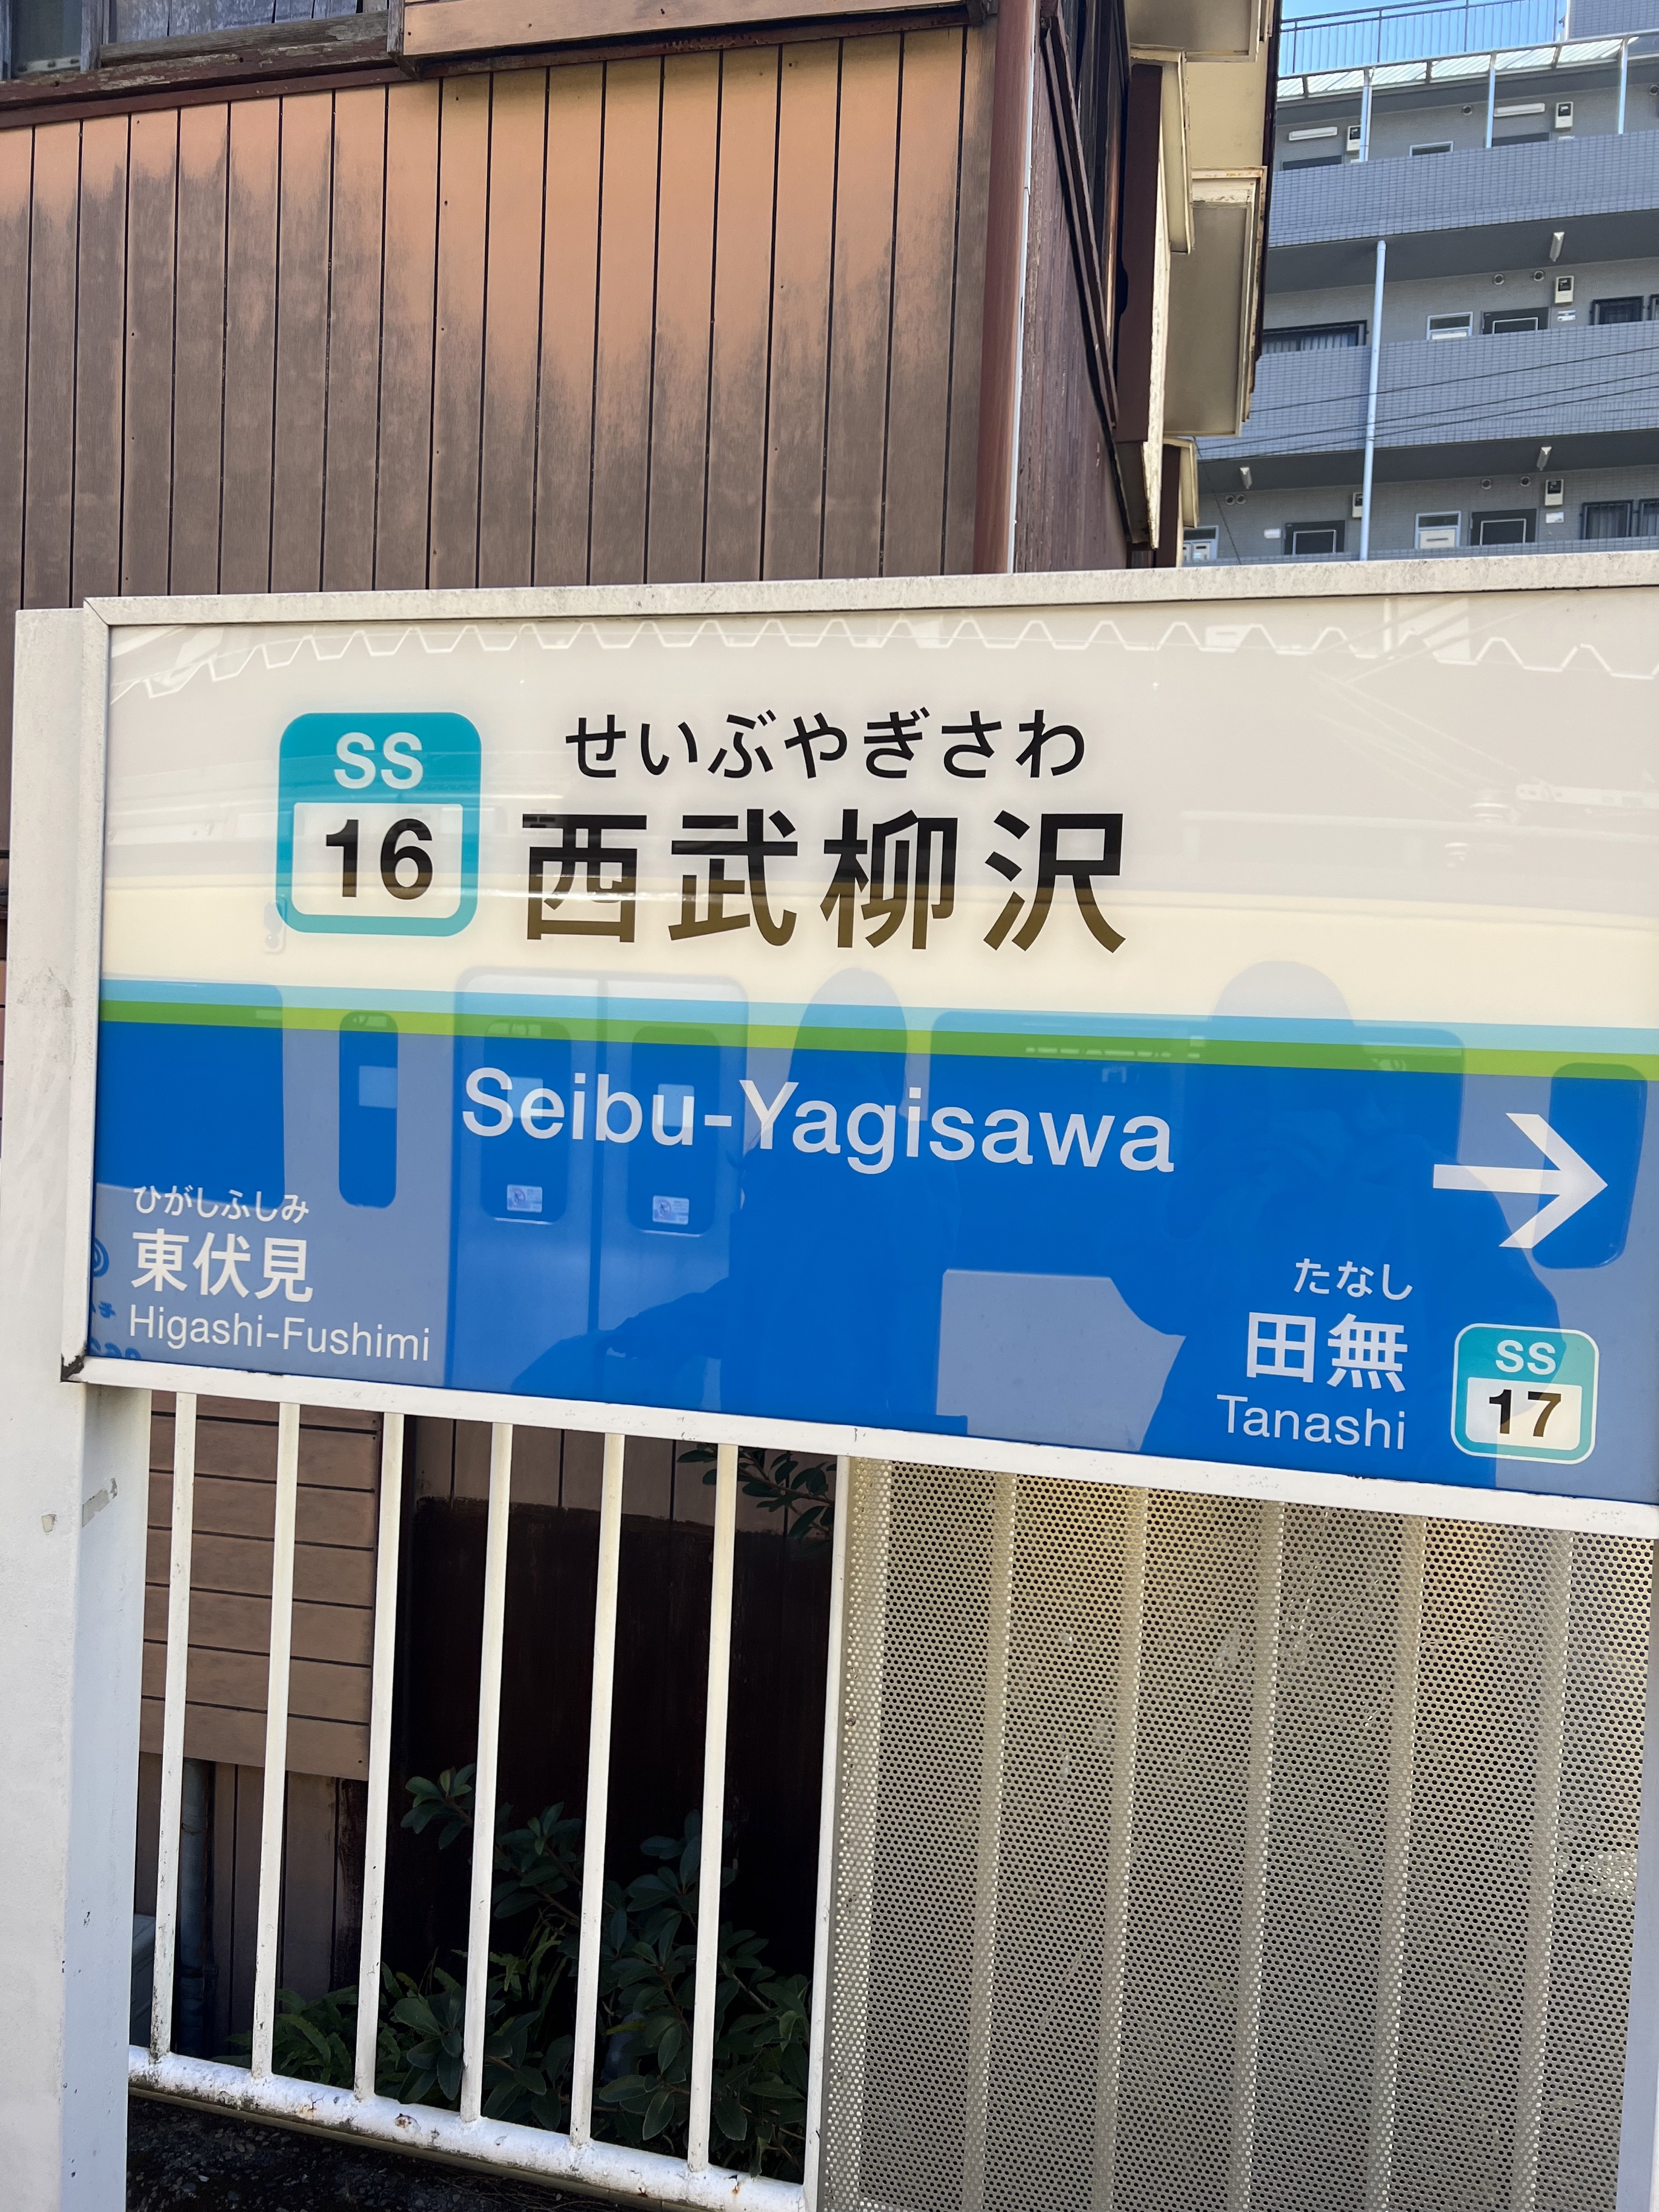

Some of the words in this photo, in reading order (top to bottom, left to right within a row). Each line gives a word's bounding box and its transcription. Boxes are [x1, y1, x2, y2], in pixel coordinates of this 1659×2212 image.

[333, 731, 424, 789] SS
[565, 707, 1085, 780] せいぶやぎさわ
[325, 817, 434, 900] 16
[522, 808, 1126, 954] 西武柳沢
[462, 1067, 1174, 1175] Seibu-Yagisawa
[133, 1185, 310, 1223] ひがしふしみ
[131, 1228, 313, 1303] 東伏見
[1294, 1258, 1413, 1301] たなし
[130, 1304, 430, 1361] Higashi-Fushimi
[1246, 1312, 1408, 1392] 田無
[1495, 1339, 1557, 1375] SS
[1217, 1394, 1406, 1450] Tanashi
[1489, 1389, 1562, 1438] 17
